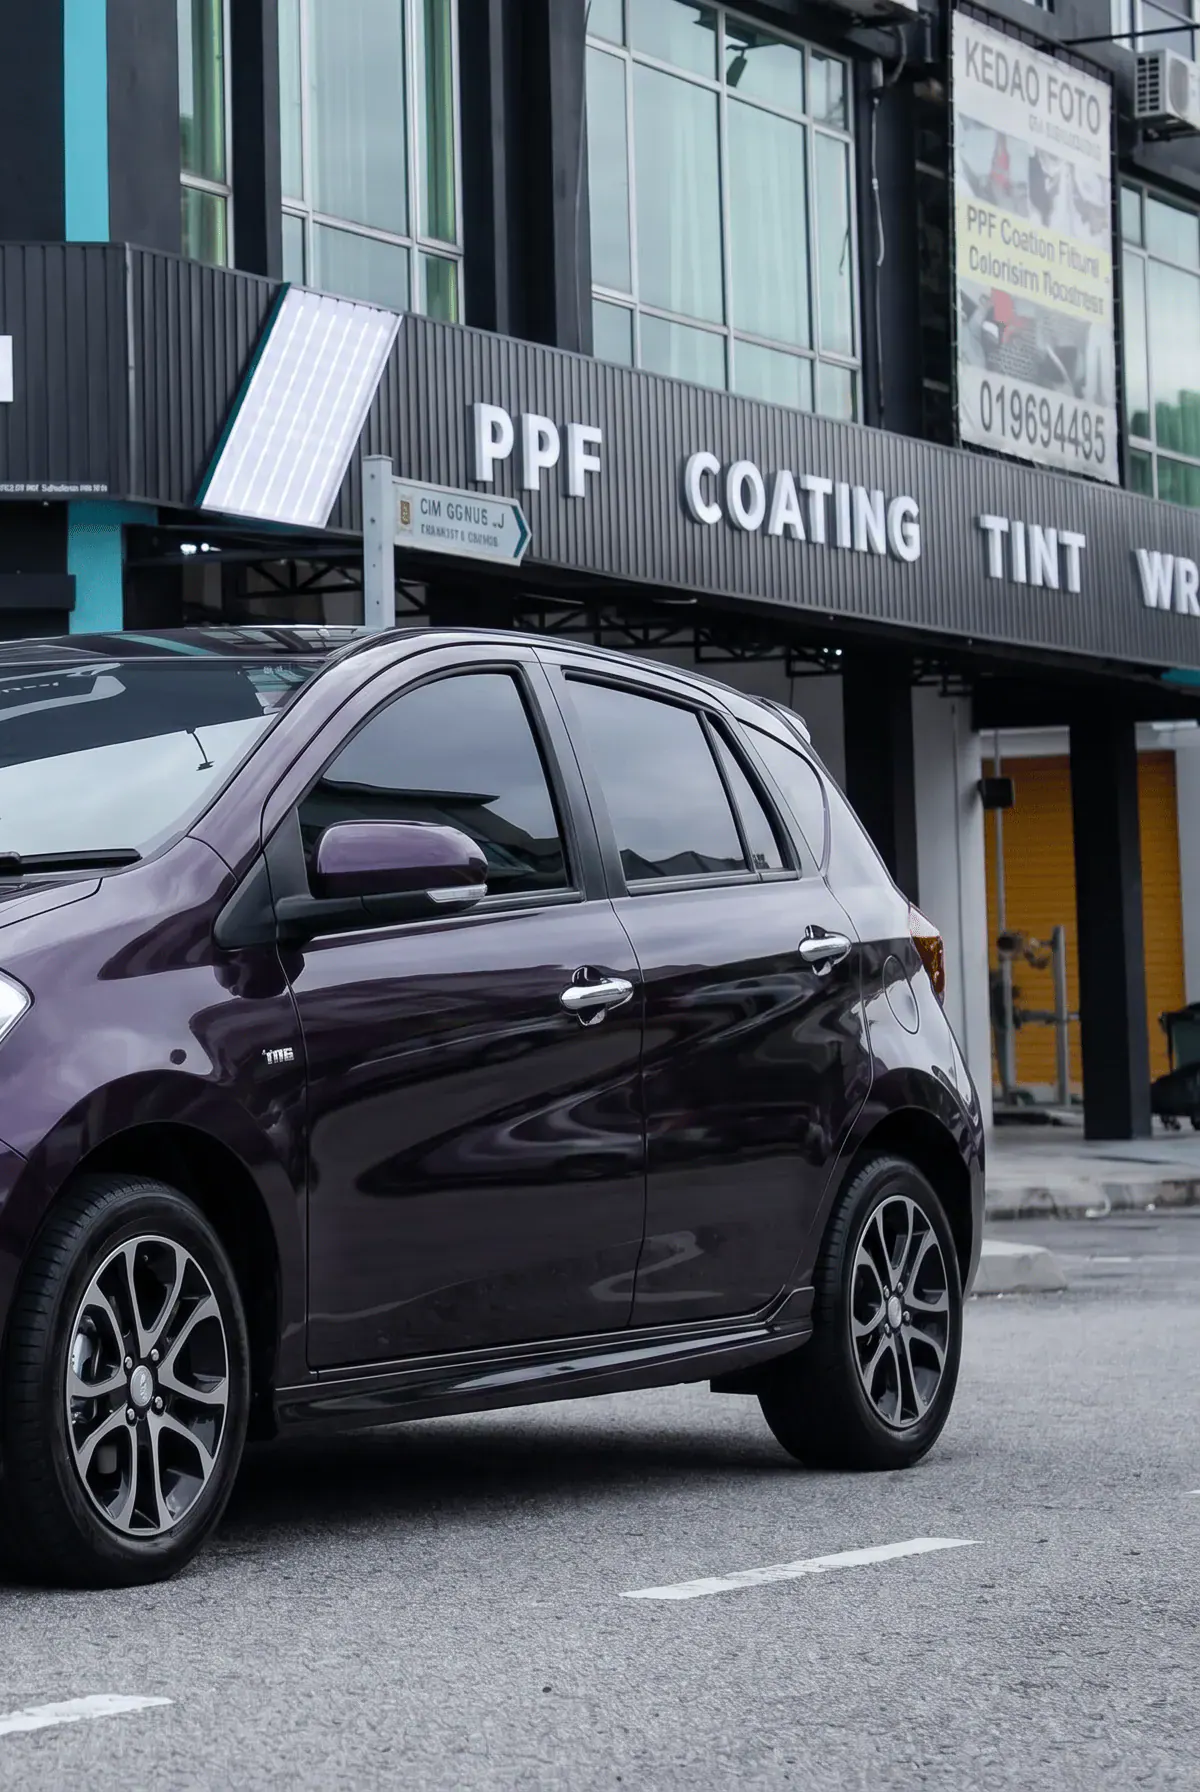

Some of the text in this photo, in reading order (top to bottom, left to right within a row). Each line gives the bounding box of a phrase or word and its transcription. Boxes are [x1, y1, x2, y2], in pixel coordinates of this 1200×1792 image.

[965, 36, 1101, 136] KEDAO FOTO
[967, 204, 997, 239] PPF
[472, 402, 603, 498] PPF
[684, 450, 922, 563] COATING
[979, 513, 1086, 594] TINT
